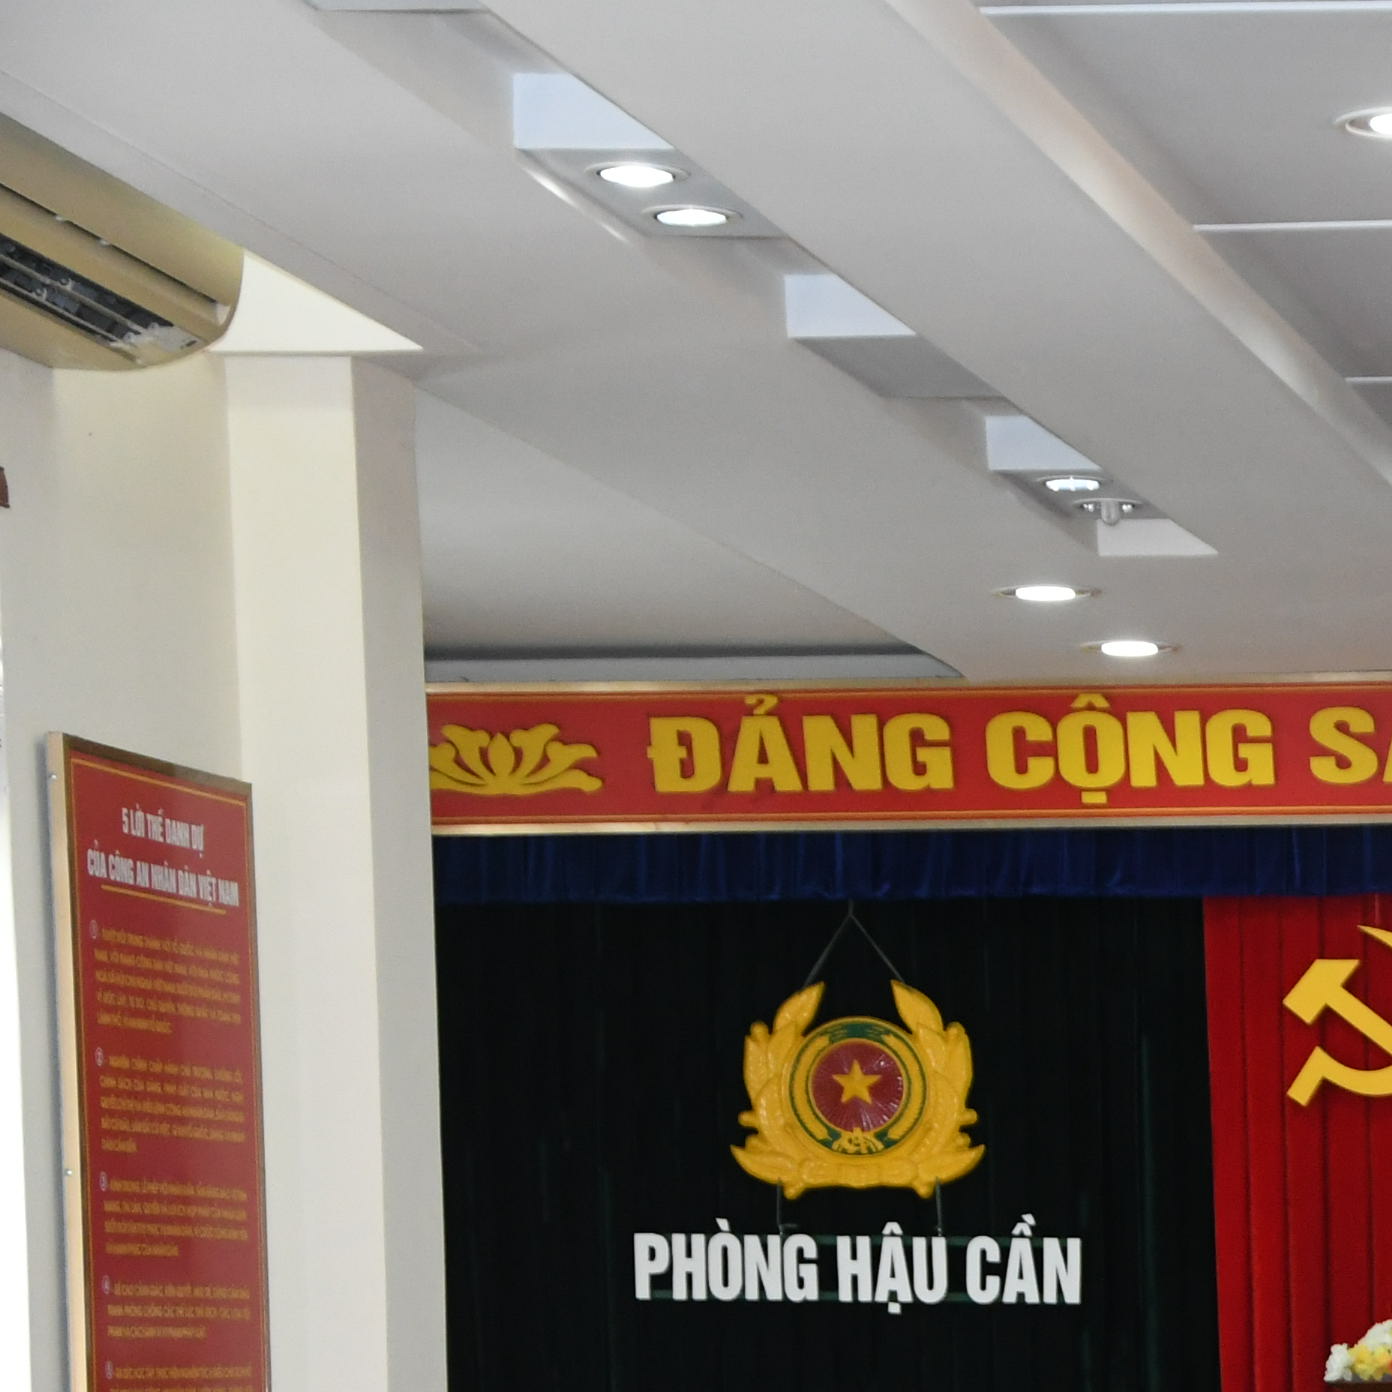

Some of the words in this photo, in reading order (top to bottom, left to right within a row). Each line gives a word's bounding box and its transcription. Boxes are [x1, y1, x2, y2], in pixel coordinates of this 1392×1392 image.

[647, 694, 954, 793] ĐẢNG
[986, 693, 1275, 804] CỘNG
[122, 807, 129, 834] 5
[87, 839, 107, 878] CỦA
[108, 850, 134, 885] CÔNG
[136, 860, 149, 888] AN
[151, 860, 177, 894] NHÂN
[198, 869, 216, 907] VIỆT
[218, 878, 239, 906] NAM
[633, 1218, 819, 1303] PHÒNG
[836, 1221, 949, 1314] HẬU
[965, 1213, 1082, 1305] CẦN
